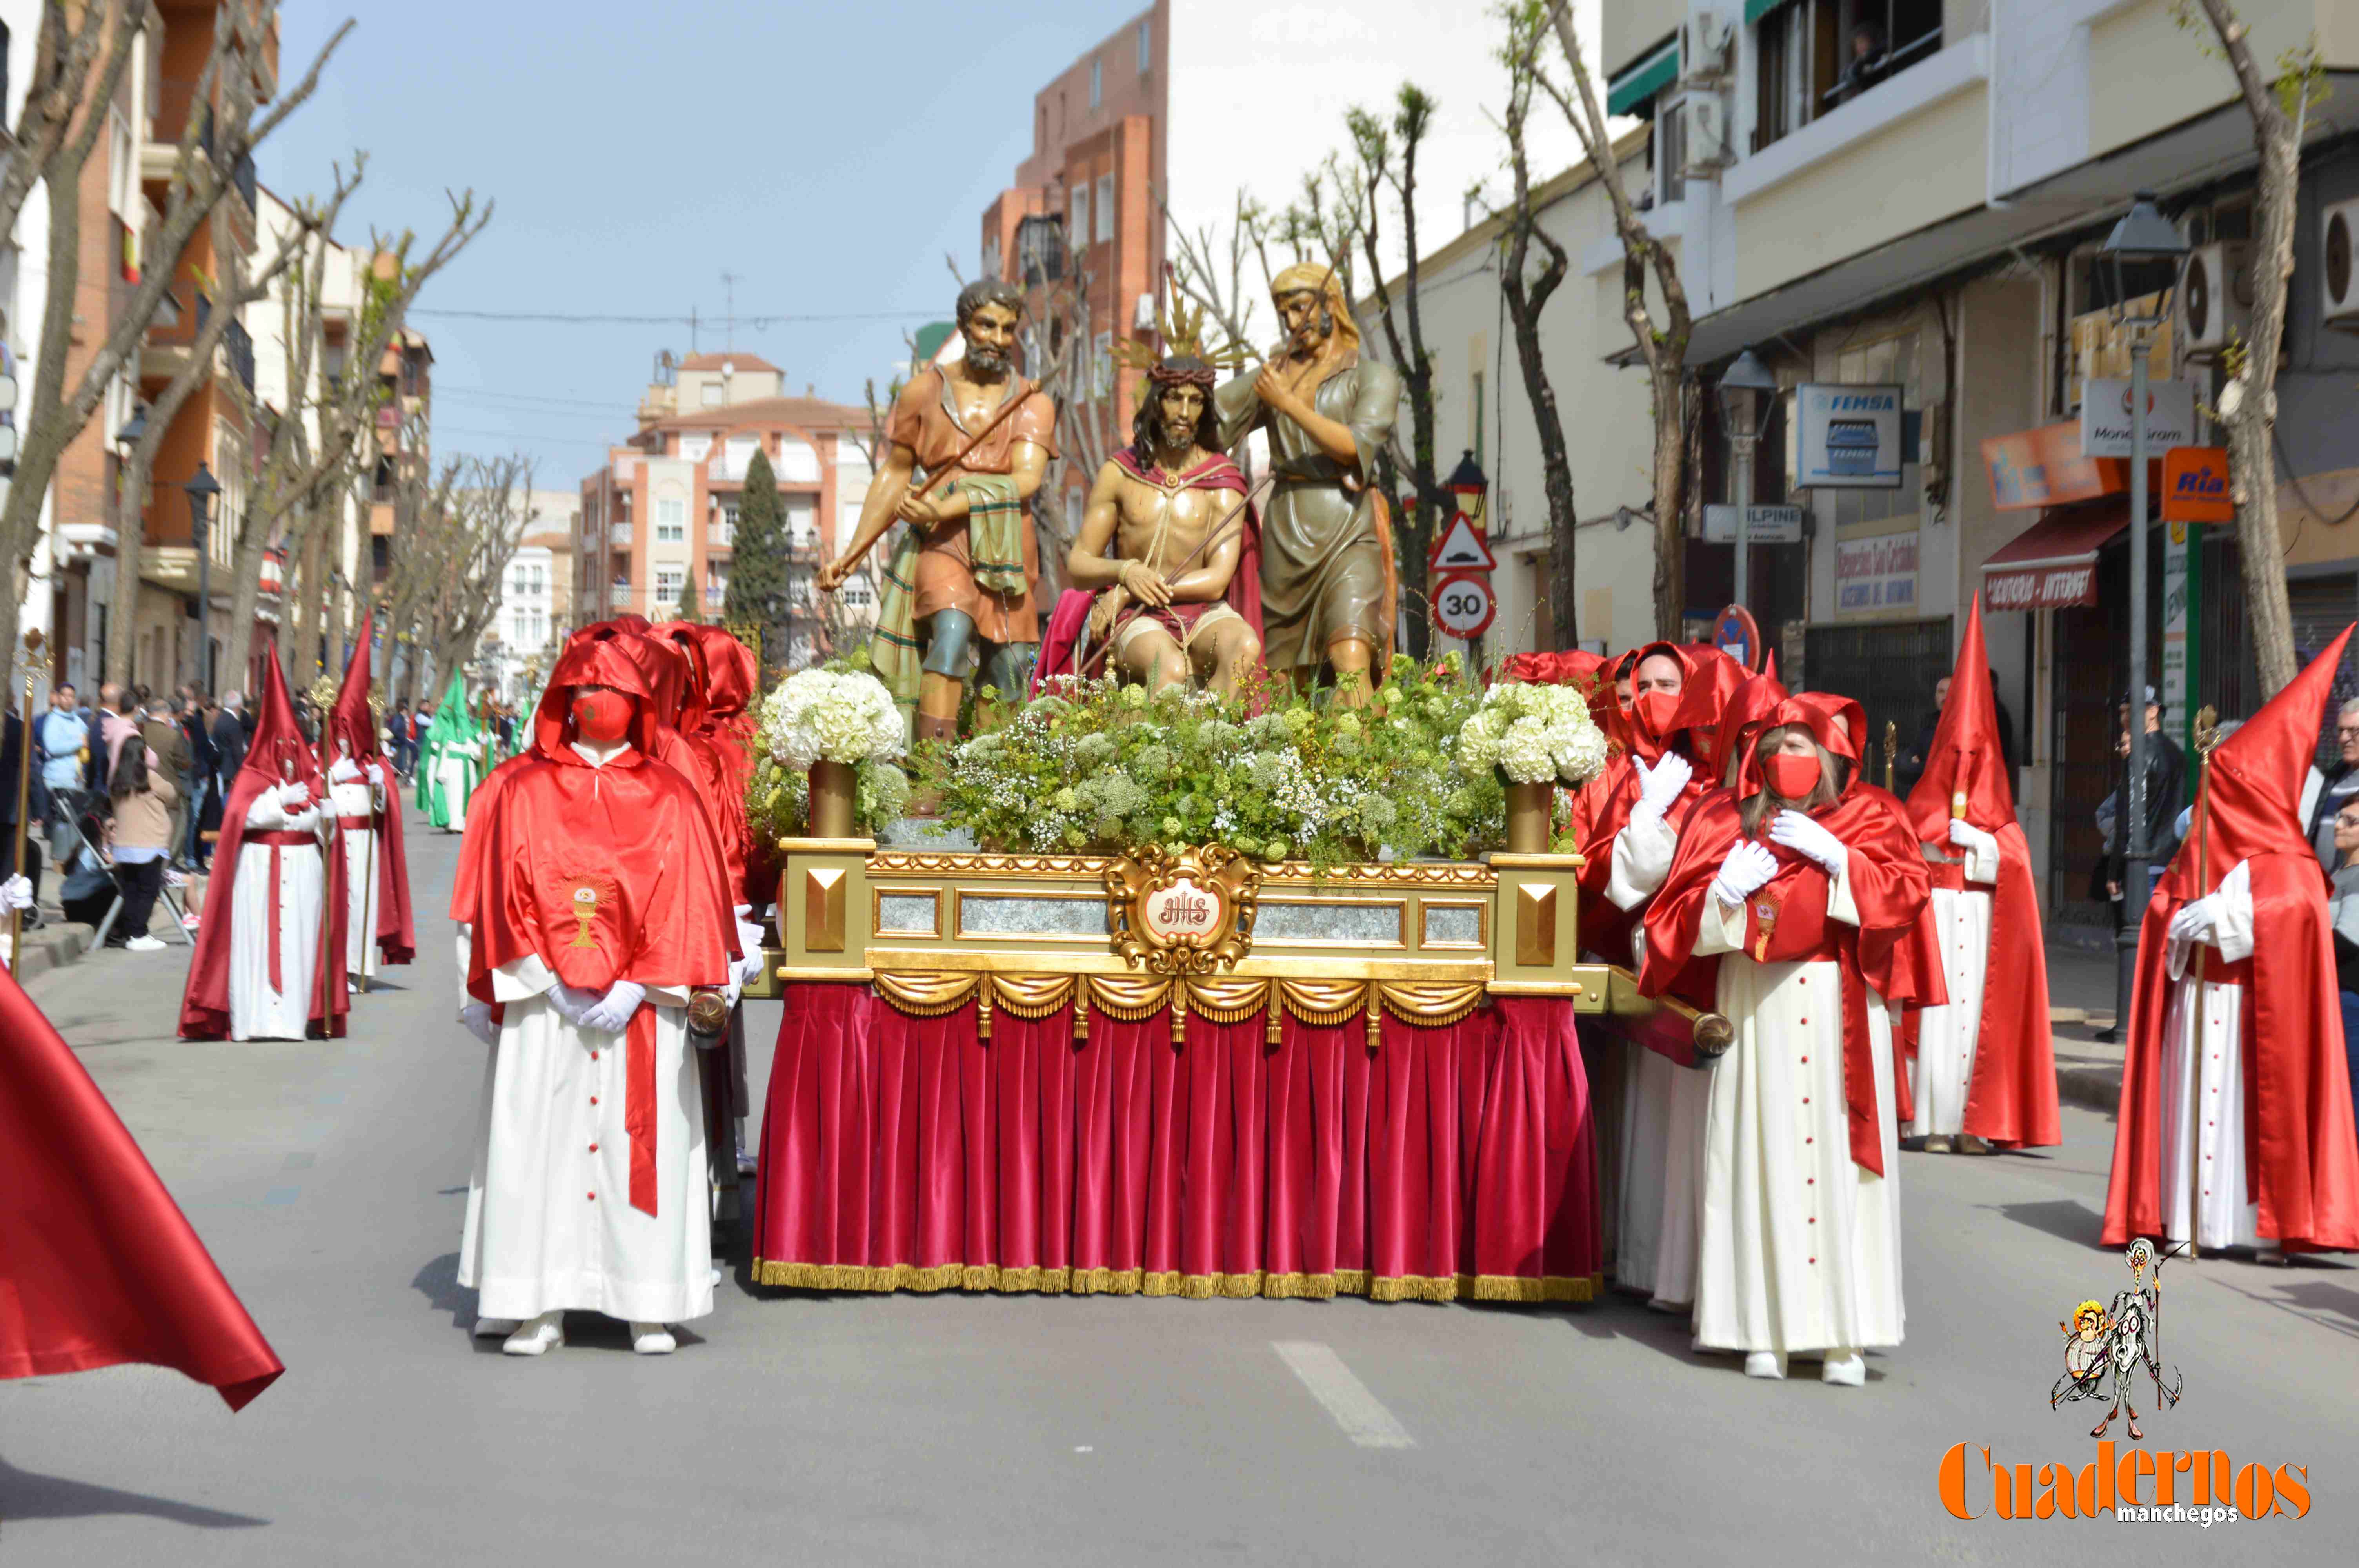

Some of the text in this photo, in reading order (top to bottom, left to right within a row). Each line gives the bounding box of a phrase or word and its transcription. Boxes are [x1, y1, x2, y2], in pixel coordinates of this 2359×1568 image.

[1831, 395, 1894, 409] FEMSA
[2177, 466, 2224, 492] Ria
[1446, 594, 1480, 615] 30
